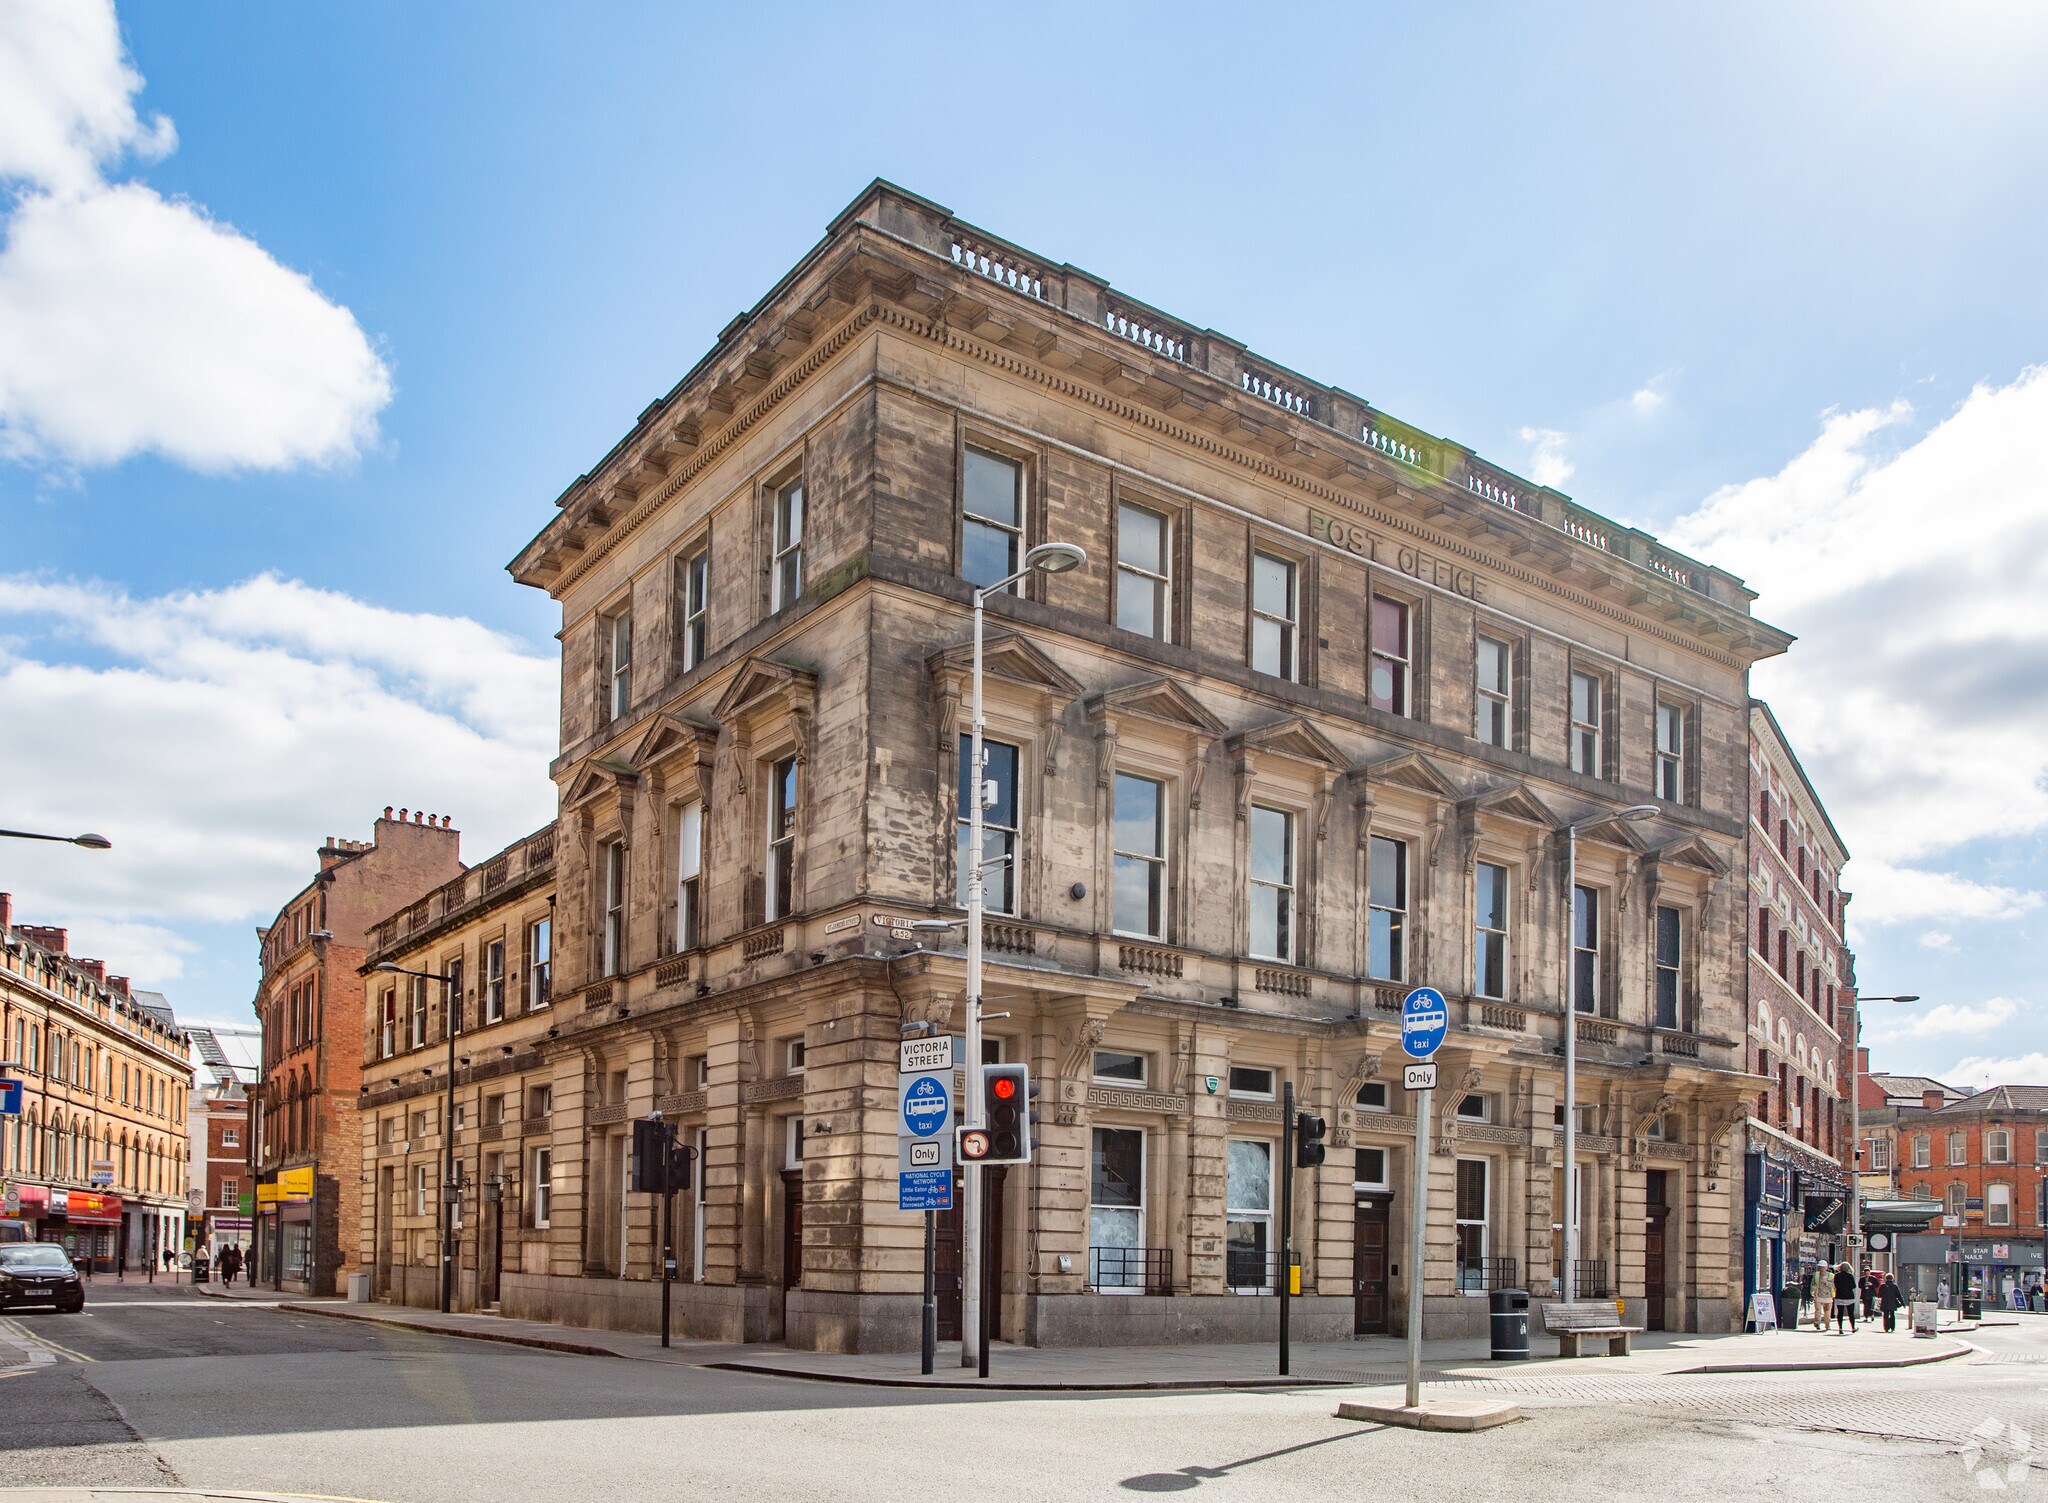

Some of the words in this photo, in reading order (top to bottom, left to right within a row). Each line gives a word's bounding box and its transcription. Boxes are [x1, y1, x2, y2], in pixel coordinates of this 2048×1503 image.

[1309, 508, 1384, 561] POST
[1398, 547, 1488, 604] OFFICE
[877, 916, 914, 930] VICTORIA
[894, 931, 909, 939] A52
[904, 1041, 949, 1055] VICTORIA
[1413, 1038, 1429, 1049] taxi
[908, 1054, 944, 1067] STREET
[1408, 1071, 1433, 1084] Only
[918, 1120, 933, 1130] taxi
[915, 1148, 935, 1160] Only
[1808, 1198, 1841, 1231] PLATINUM
